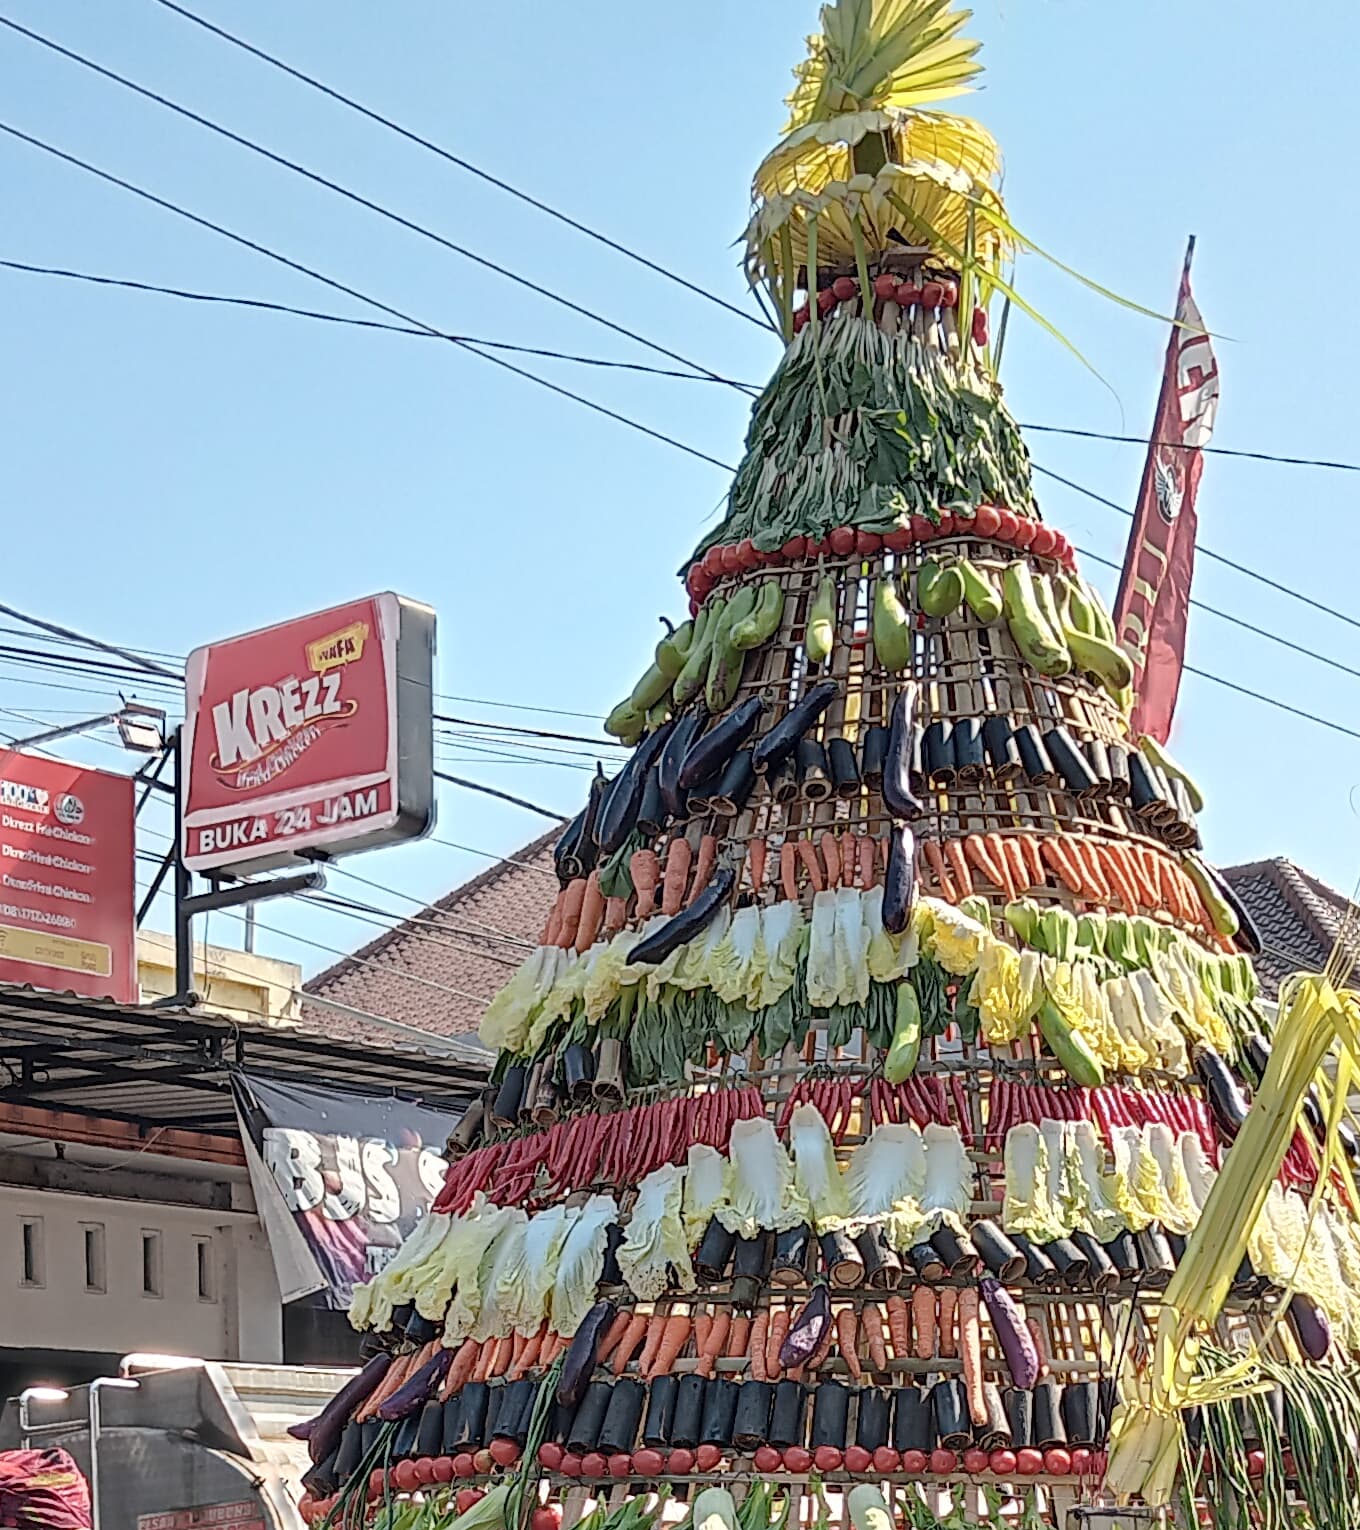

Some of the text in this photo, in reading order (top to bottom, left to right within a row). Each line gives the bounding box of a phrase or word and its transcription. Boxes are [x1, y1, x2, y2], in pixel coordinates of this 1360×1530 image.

[318, 635, 355, 661] WAFA
[212, 671, 341, 768] KREZZ
[199, 788, 378, 853] BUKA 24 JAM
